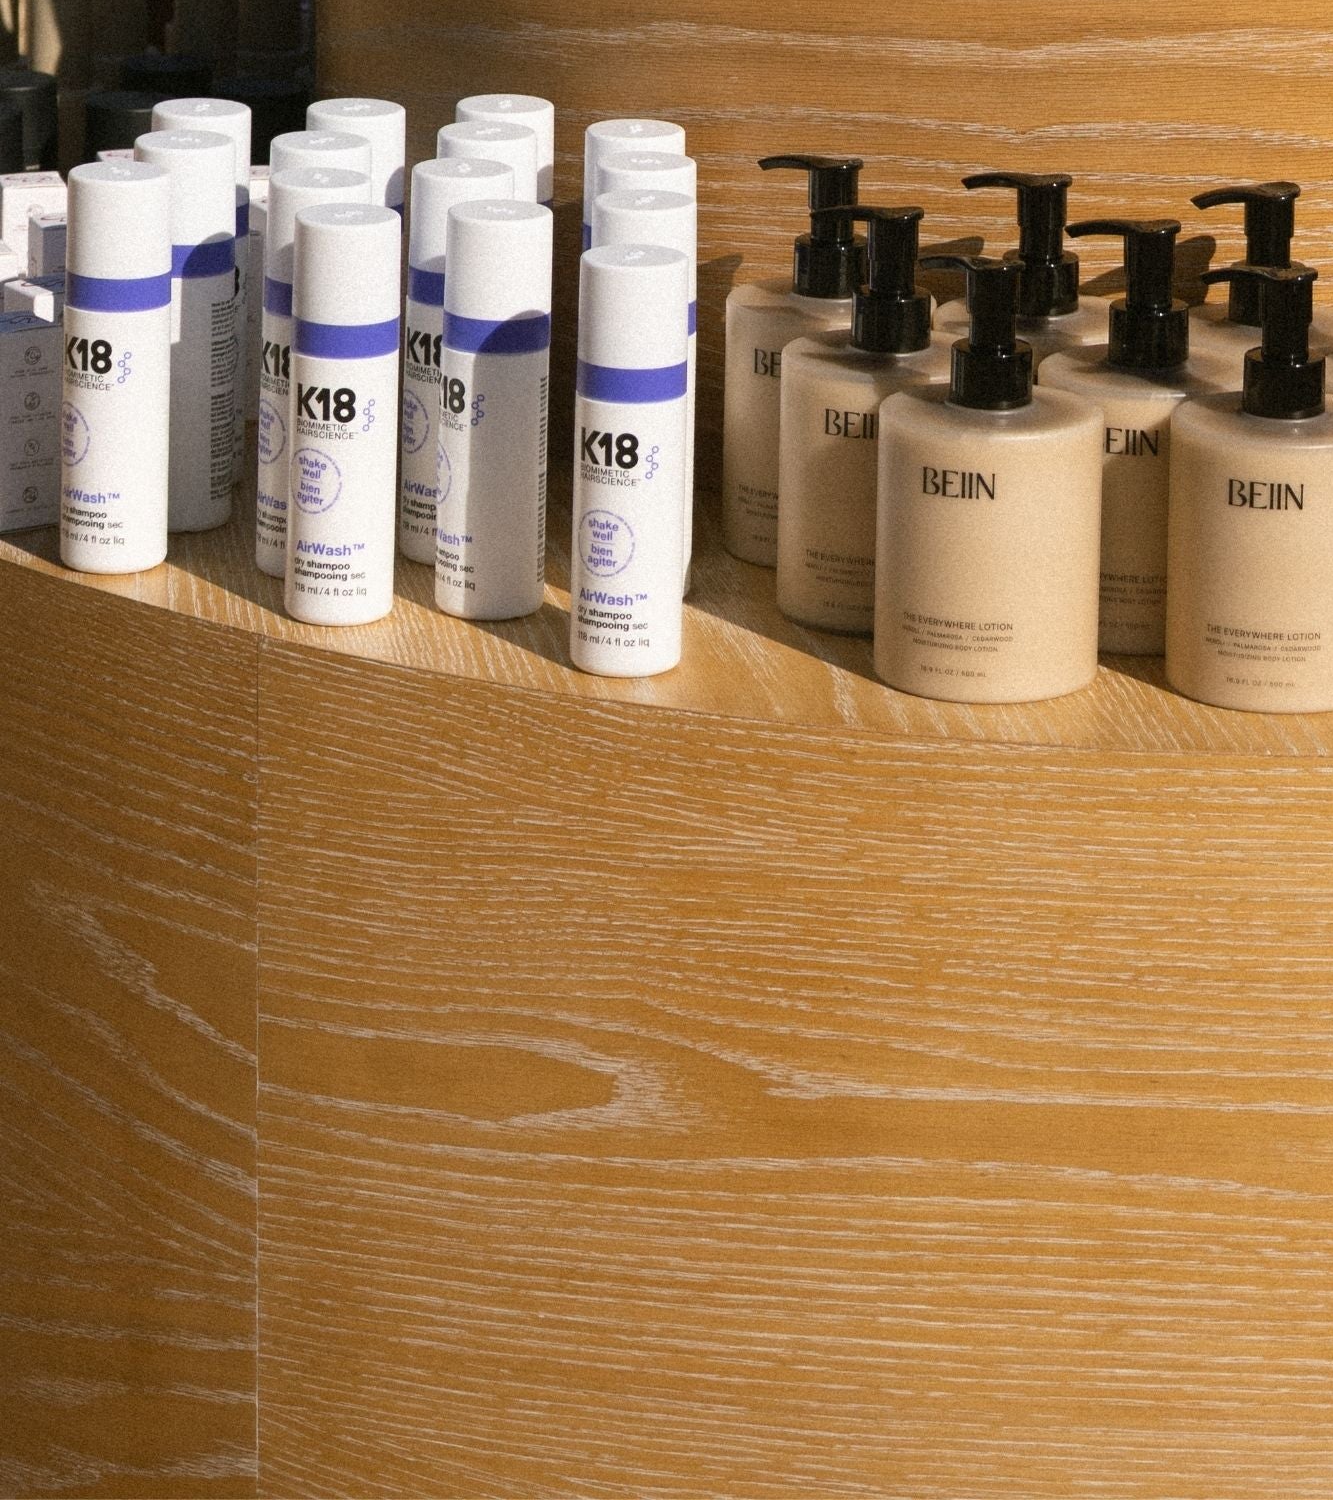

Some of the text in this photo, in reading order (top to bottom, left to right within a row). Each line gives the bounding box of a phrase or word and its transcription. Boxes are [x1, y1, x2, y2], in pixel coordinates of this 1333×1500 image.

[65, 334, 112, 374] K18
[754, 348, 782, 378] BE
[297, 383, 356, 423] K18
[297, 420, 348, 431] BIOMIMETIC
[825, 408, 875, 440] BEII
[581, 426, 639, 469] K18
[1104, 427, 1159, 456] EIIN
[299, 456, 327, 471] shake
[302, 467, 321, 479] well
[300, 482, 320, 495] bien
[921, 466, 996, 500] BEIIN
[297, 491, 324, 506] agiter
[1227, 478, 1304, 510] BEIIN
[107, 521, 123, 529] sec
[588, 518, 619, 531] shake
[100, 537, 111, 545] oz
[113, 536, 124, 546] liq
[592, 530, 613, 540] well
[591, 543, 613, 556] bien
[294, 556, 350, 571] dry shampoo
[460, 565, 474, 573] sec
[587, 555, 618, 568] agiter
[294, 566, 366, 581] shampooing sec
[333, 586, 339, 596] fl
[342, 588, 353, 596] oz
[356, 587, 367, 597] liq
[465, 581, 476, 592] liq
[589, 608, 632, 620] shampoo
[903, 611, 1013, 631] THE EVERYWHERE LOTION
[577, 614, 648, 631] shampooing sec
[1207, 623, 1321, 641] THE EVERYWHERE LOTION
[614, 636, 620, 646] fl
[623, 639, 635, 647] oz
[638, 638, 650, 647] liq
